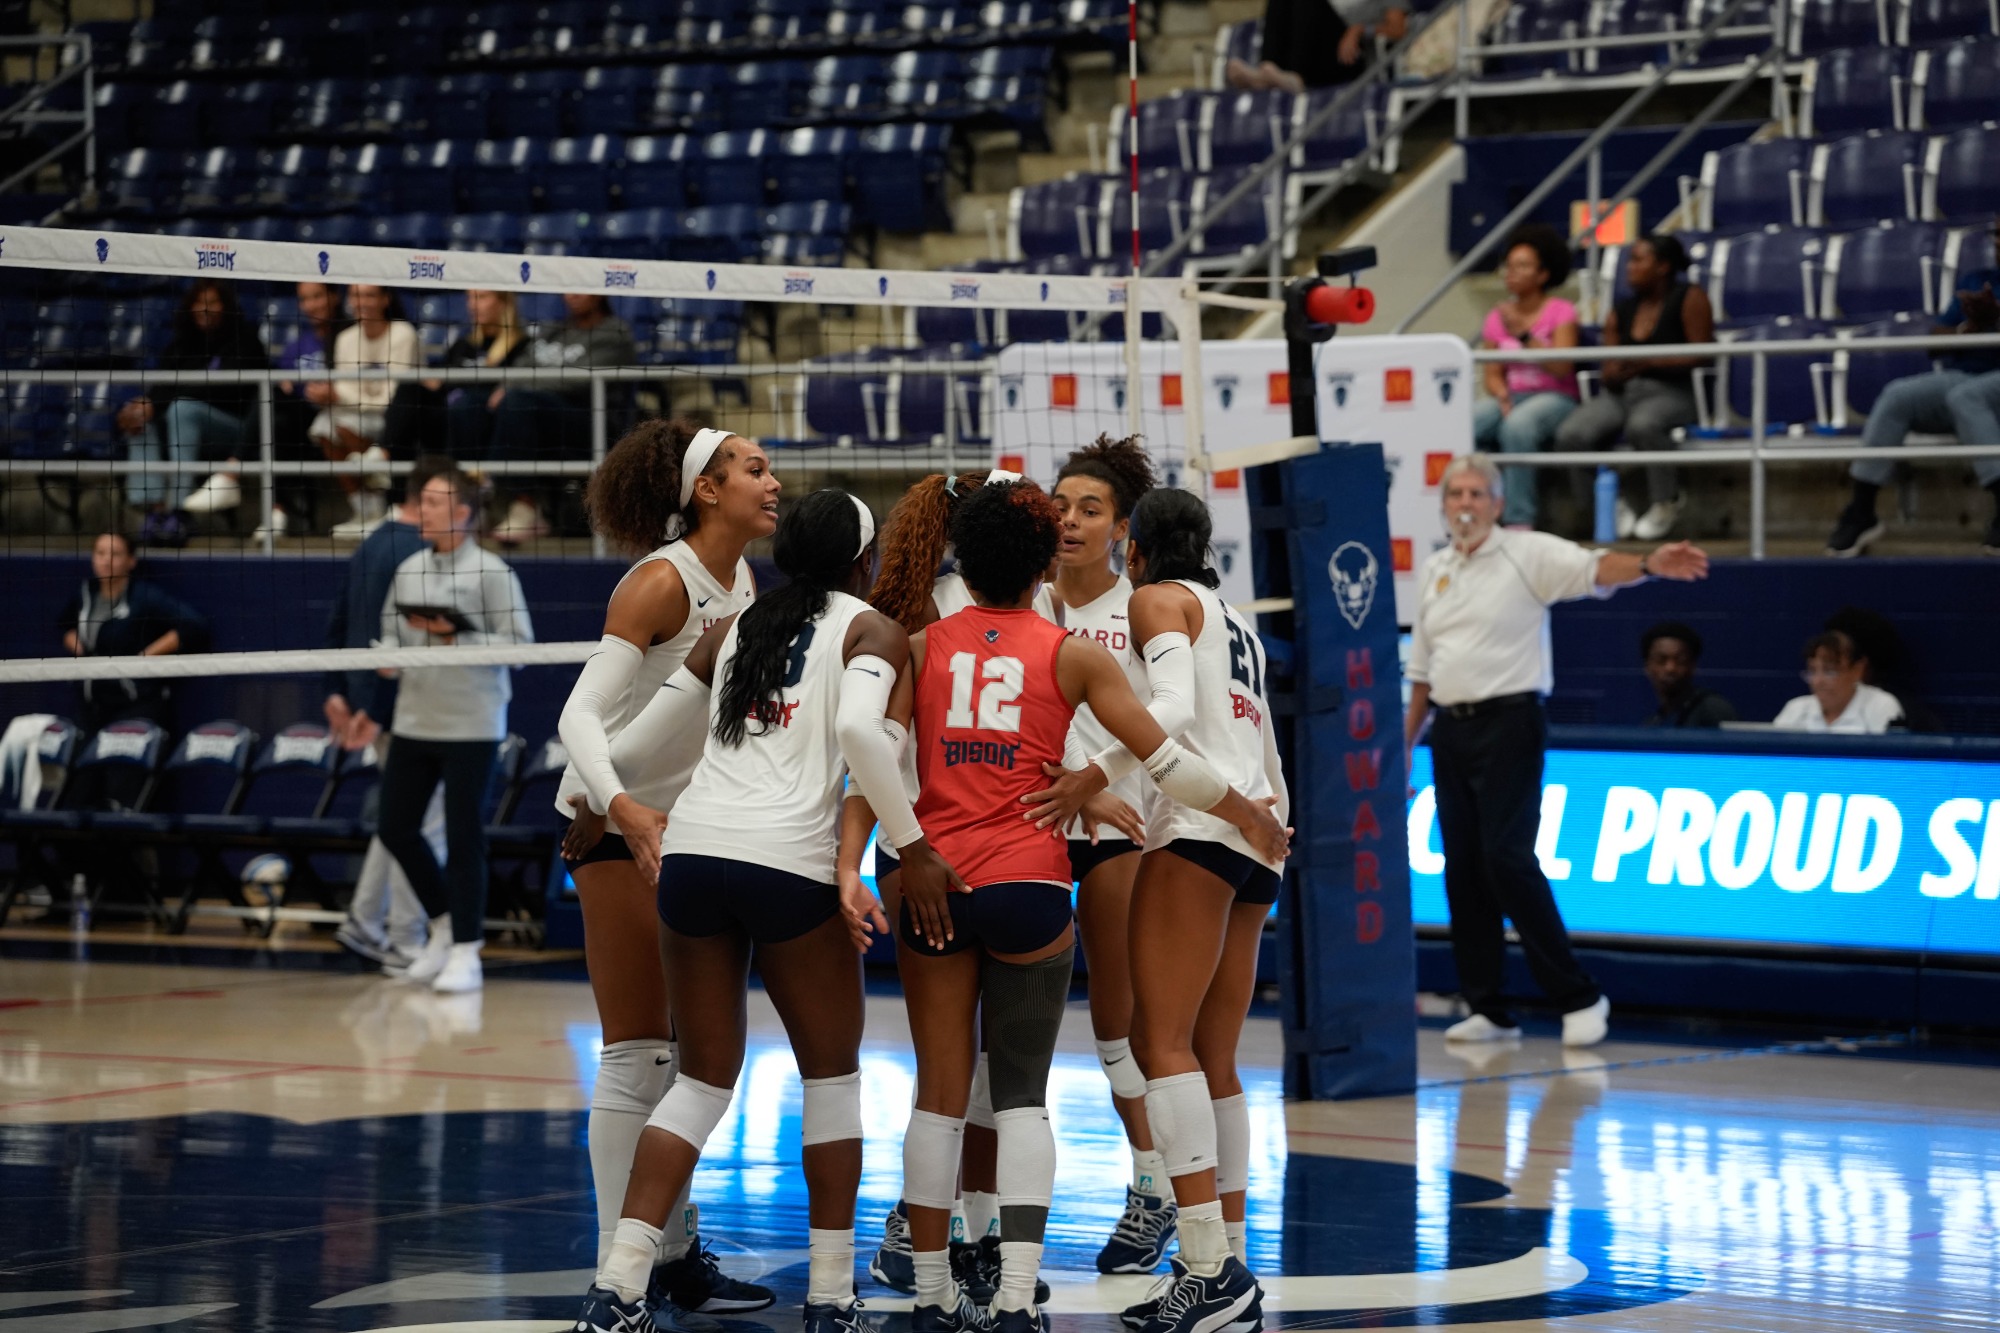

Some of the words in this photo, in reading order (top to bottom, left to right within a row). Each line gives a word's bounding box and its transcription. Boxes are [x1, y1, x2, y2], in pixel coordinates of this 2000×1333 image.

[195, 248, 237, 271] BISON
[408, 260, 446, 281] BISON
[604, 269, 638, 289] BISON
[1224, 614, 1262, 699] 21
[946, 651, 1024, 732] 12
[940, 736, 1021, 770] BISON
[1345, 647, 1384, 944] HOWARD
[1592, 786, 1902, 894] PROUD
